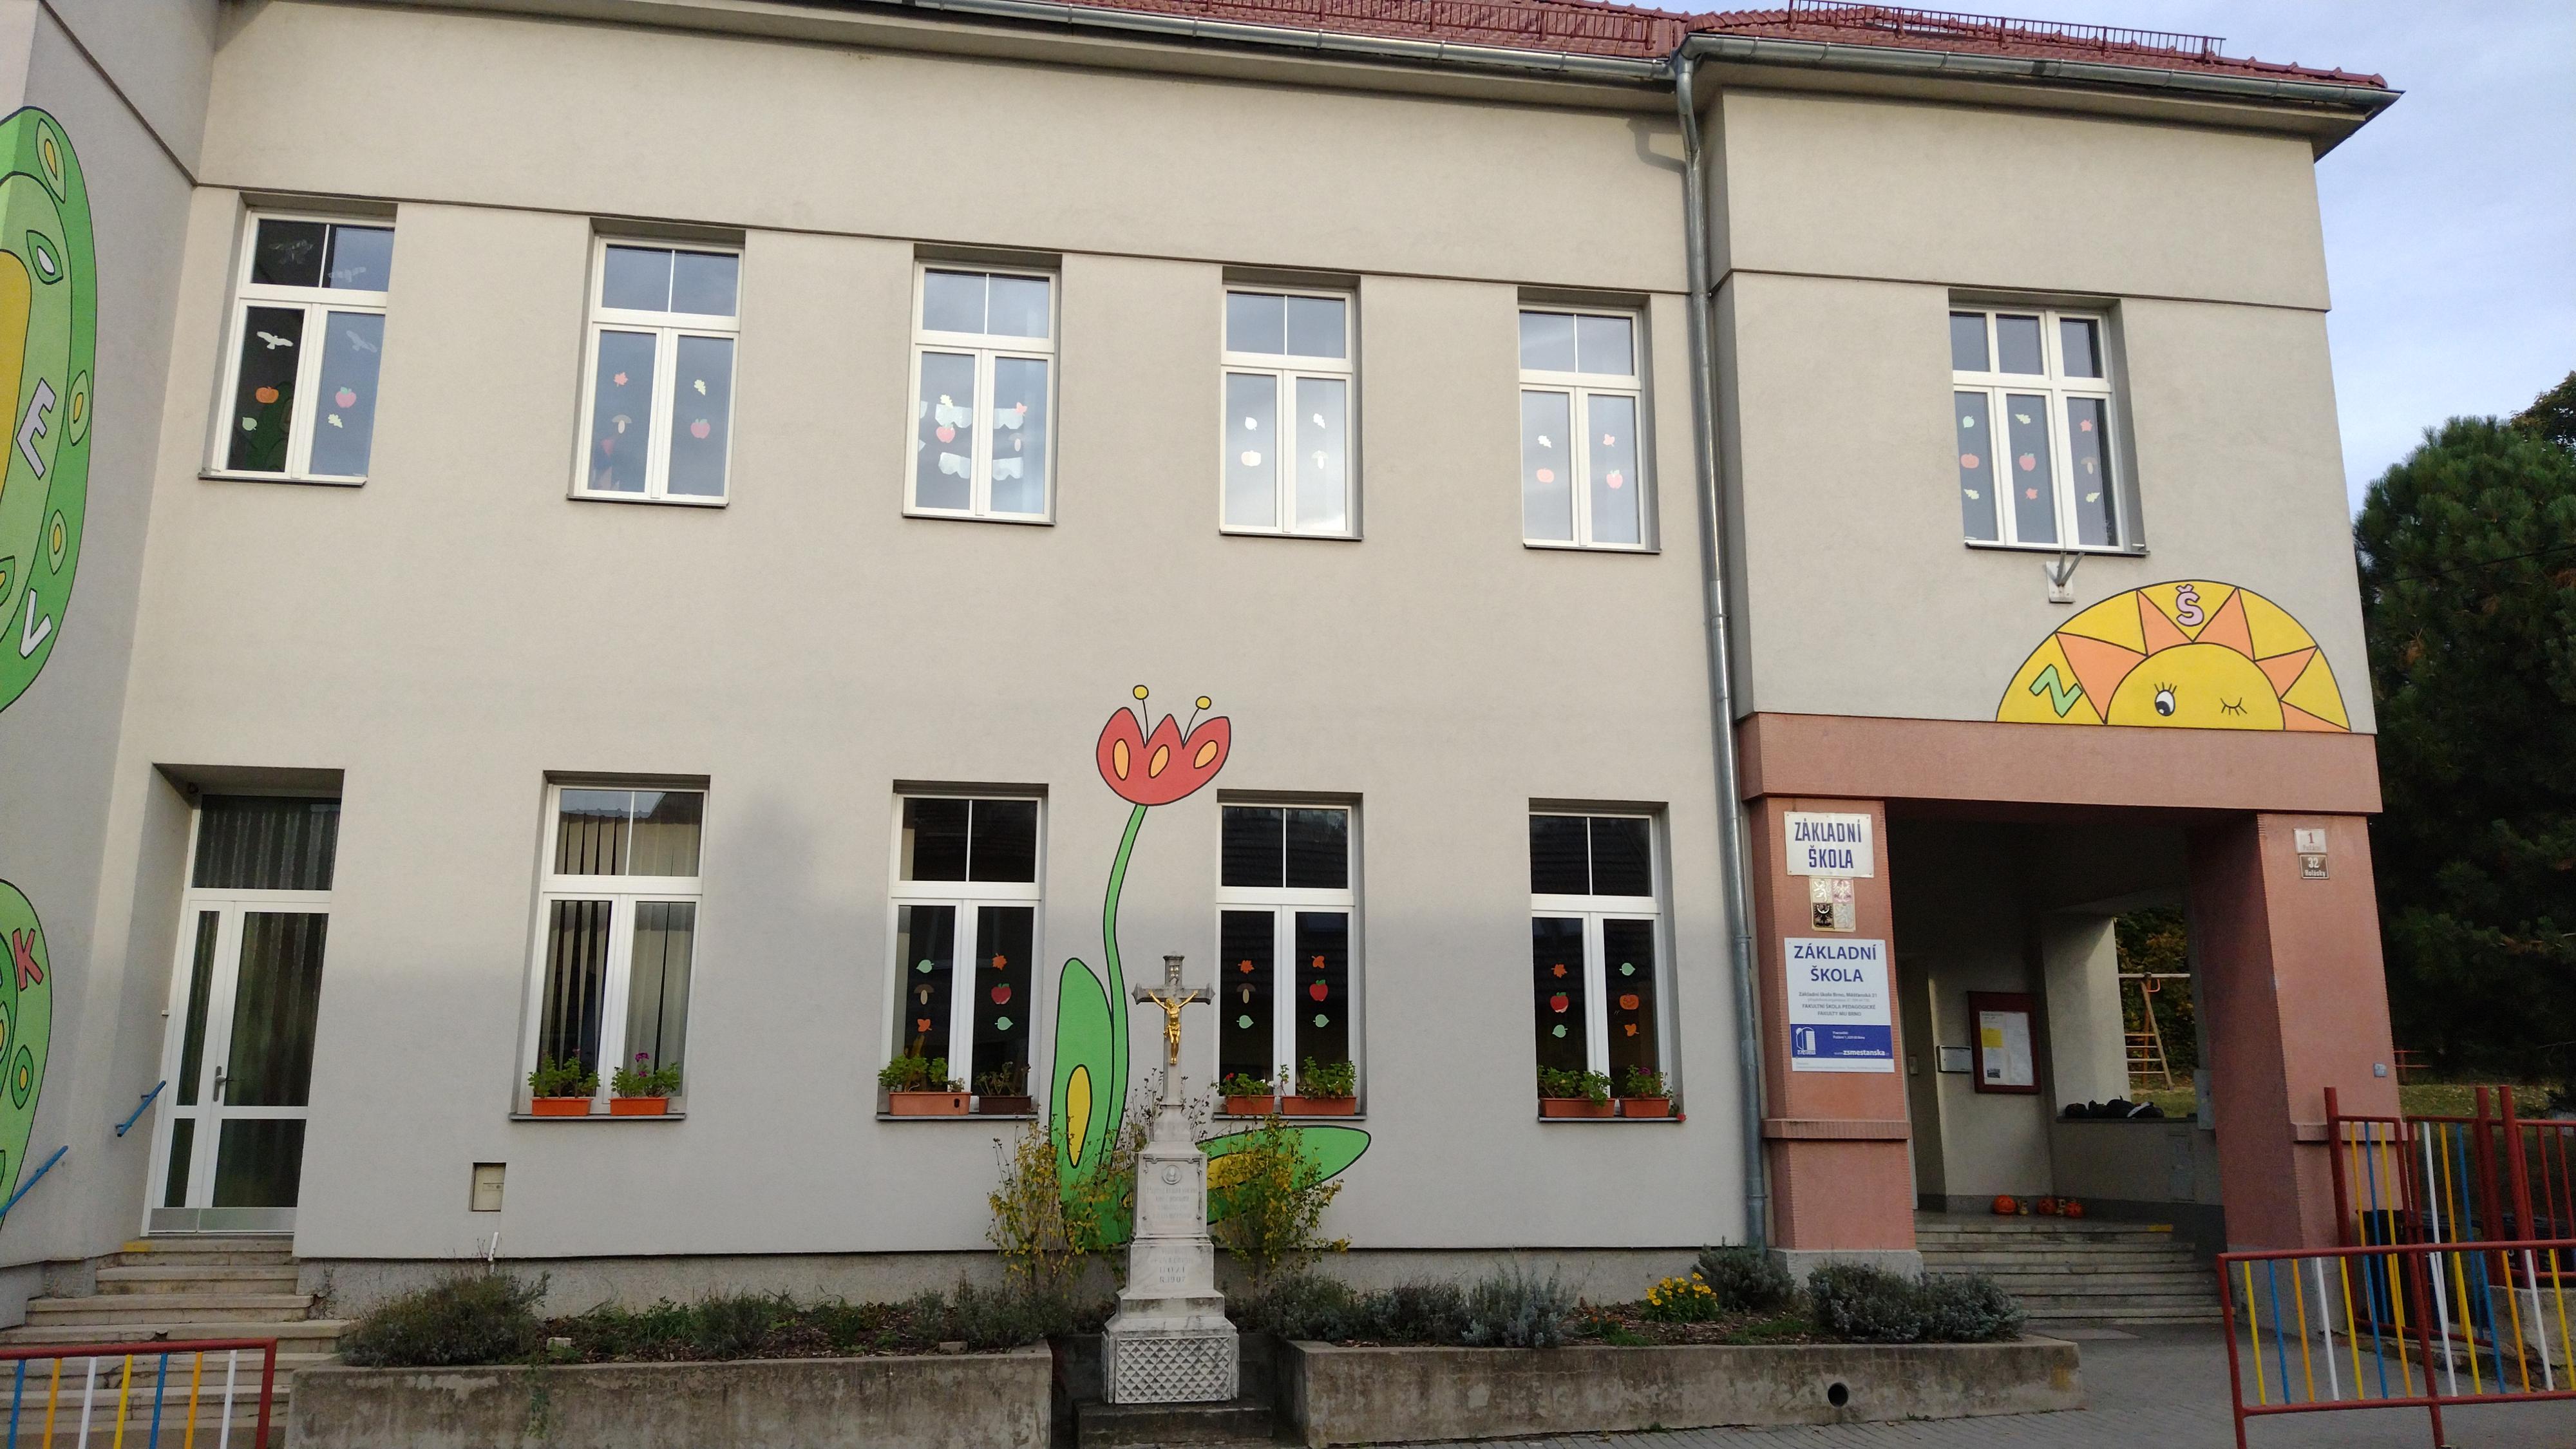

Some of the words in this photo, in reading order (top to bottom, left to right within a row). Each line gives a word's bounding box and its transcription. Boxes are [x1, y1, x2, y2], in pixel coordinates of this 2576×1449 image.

[2175, 583, 2204, 627] Š
[1794, 817, 1862, 843] ZÁKLADNÍ
[2308, 832, 2315, 844] 1
[1808, 844, 1854, 869] ŠKOLA
[2307, 857, 2320, 868] 32
[12, 927, 44, 992] K
[1794, 943, 1877, 960] ZÁKLADNÍ
[1810, 965, 1864, 982] ŠKOLA
